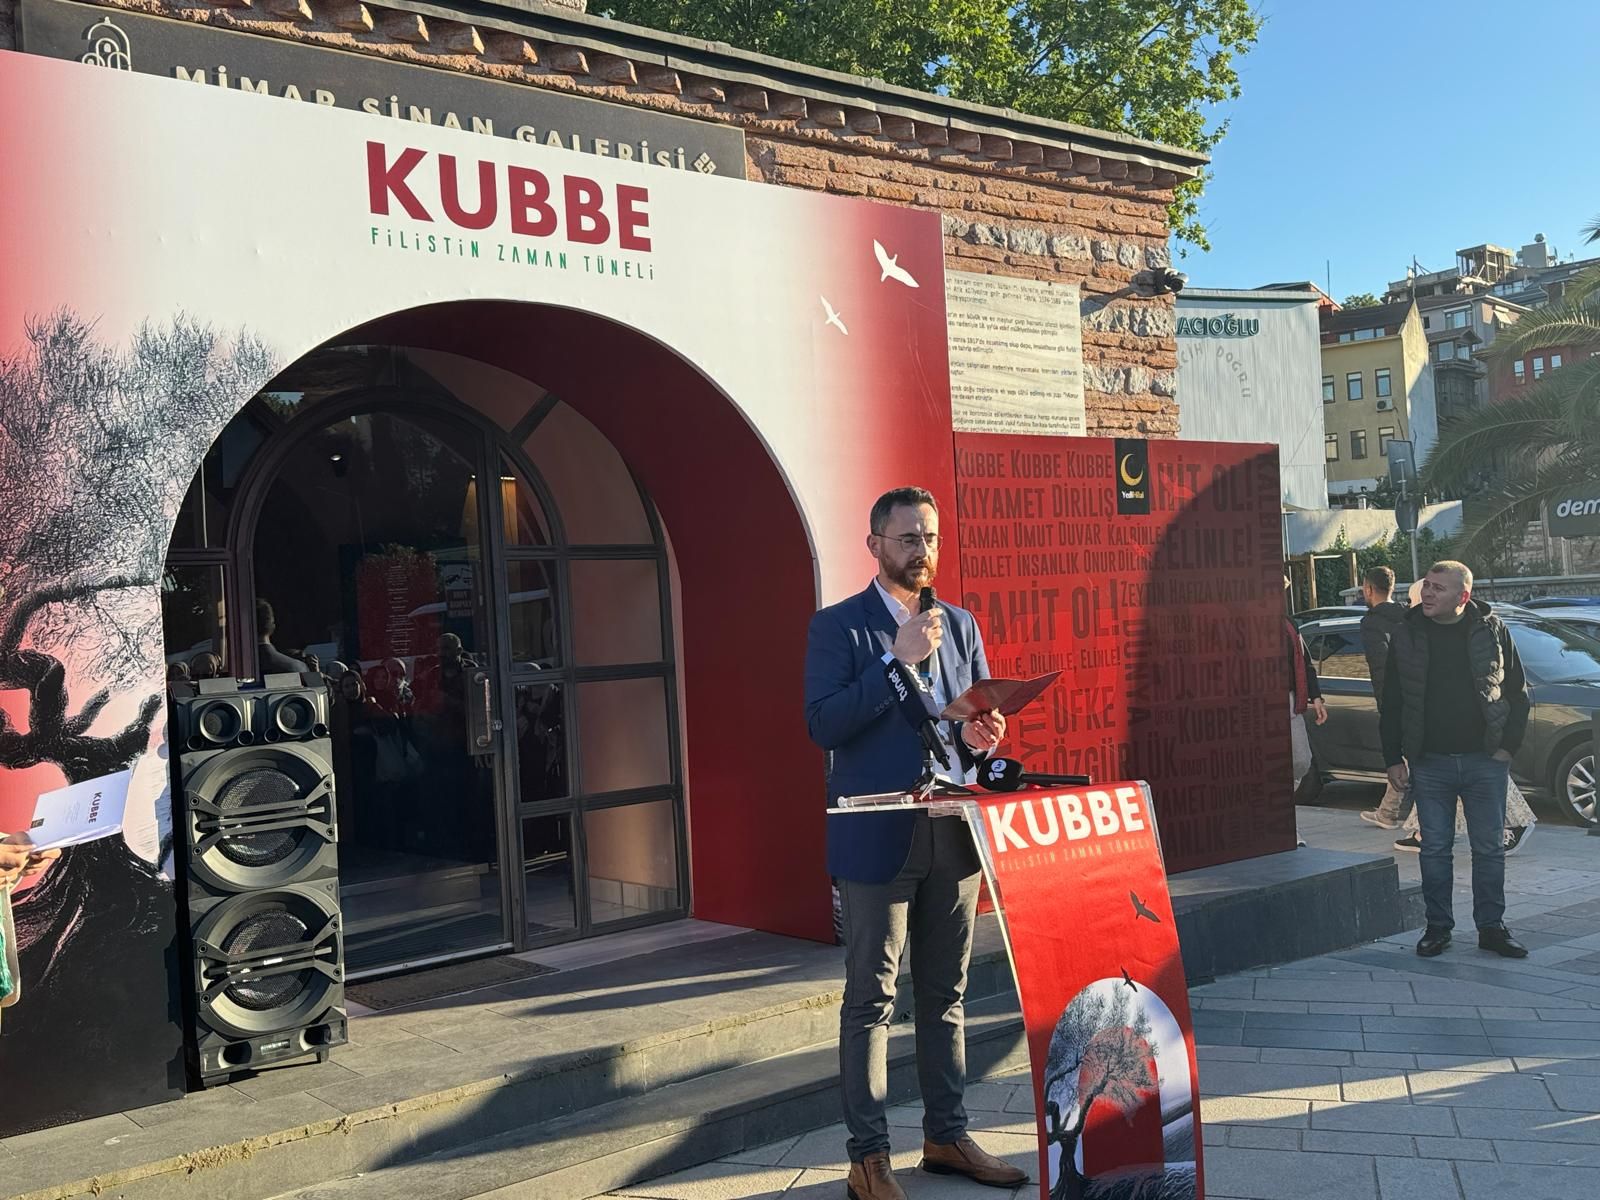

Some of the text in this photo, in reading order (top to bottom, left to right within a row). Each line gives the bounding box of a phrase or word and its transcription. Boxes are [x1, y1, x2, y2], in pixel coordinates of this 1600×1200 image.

[366, 140, 652, 253] KUBBE
[370, 226, 655, 280] FİLİSTİN ZAMAN TÜNELİ
[956, 447, 1113, 479] KUBBE KUBBE KUBBE
[957, 482, 1114, 522] KIYAMET DİRİLİŞ
[959, 521, 1102, 549] ZAMAN UMUT DUVAR
[1166, 521, 1254, 570] ELİNLE!
[961, 549, 1116, 578] ADALET İNSANLIK ONUR
[1071, 578, 1120, 640] OL!
[1030, 650, 1077, 675] DİLİNLE,
[1081, 646, 1121, 670] ELİNLE!
[888, 667, 908, 702] tvnet
[1053, 677, 1116, 735] ÖFKE
[1178, 705, 1240, 745] KUBBE
[88, 791, 102, 825] KUBBE
[986, 786, 1145, 853] KUBBE
